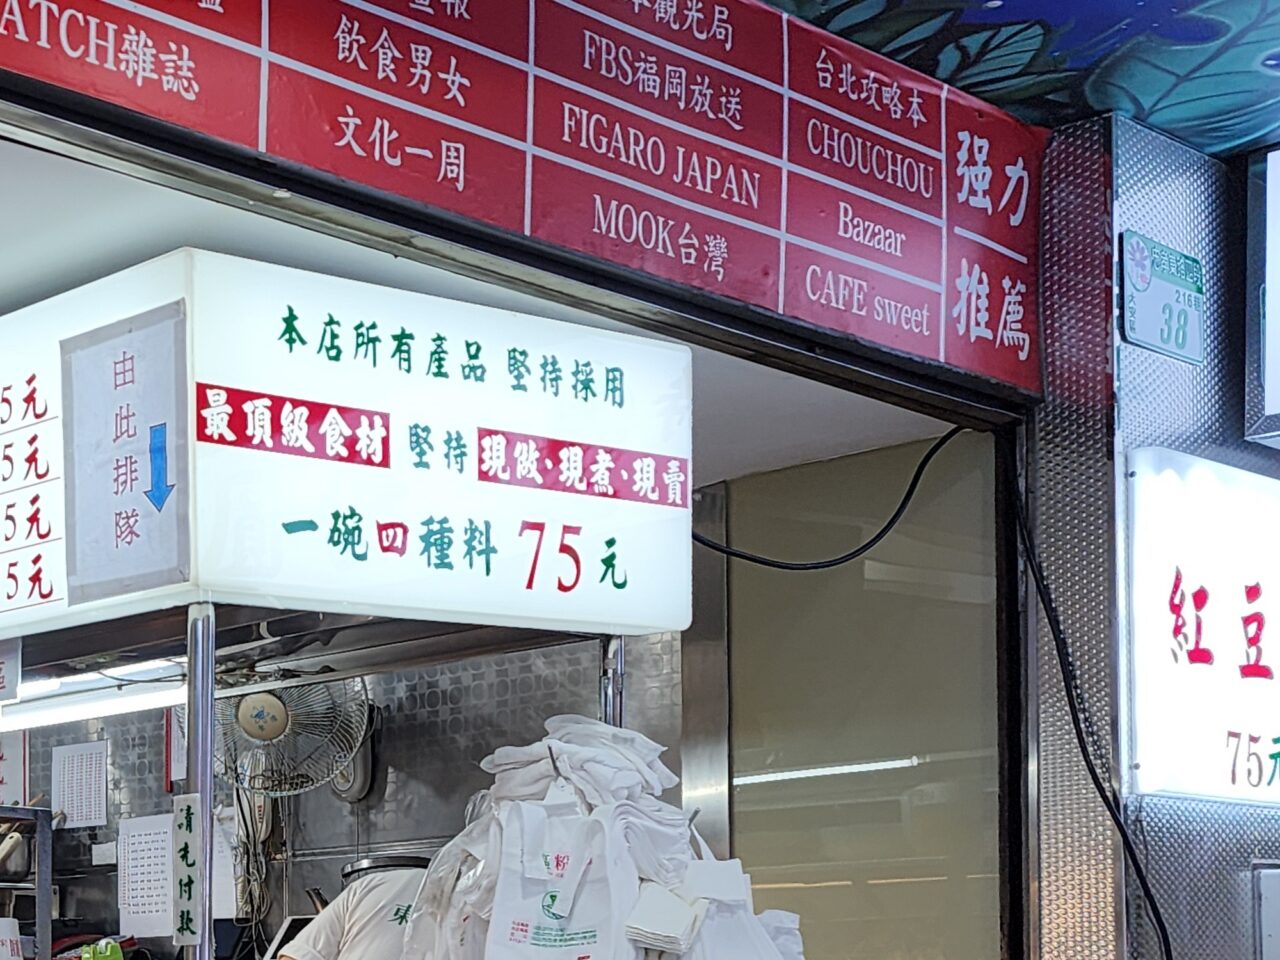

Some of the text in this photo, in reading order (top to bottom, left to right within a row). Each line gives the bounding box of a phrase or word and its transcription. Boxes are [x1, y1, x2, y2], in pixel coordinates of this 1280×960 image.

[333, 13, 471, 107] 飲食男女
[583, 29, 744, 131] FBS福岡放送
[815, 48, 928, 130] 台北攻略本
[334, 104, 466, 192] 文化一周
[561, 101, 760, 210] FIGARO JAPAN
[806, 118, 934, 200] CHOUCHOU
[592, 193, 729, 283] MOOK台灣
[837, 202, 906, 258] Bazaar
[805, 264, 931, 337] CAFE sweet
[951, 256, 1031, 362] 推薦
[1159, 302, 1189, 351] 38
[277, 305, 625, 409] 本店所有產品 堅持採用
[112, 350, 141, 549] 由此排隊
[200, 387, 389, 466] 最頂級食材
[407, 422, 469, 475] 堅持
[281, 505, 628, 594] 一碗四種料 75 元
[1168, 565, 1274, 680] 紅豆
[177, 804, 197, 937] 請先付款
